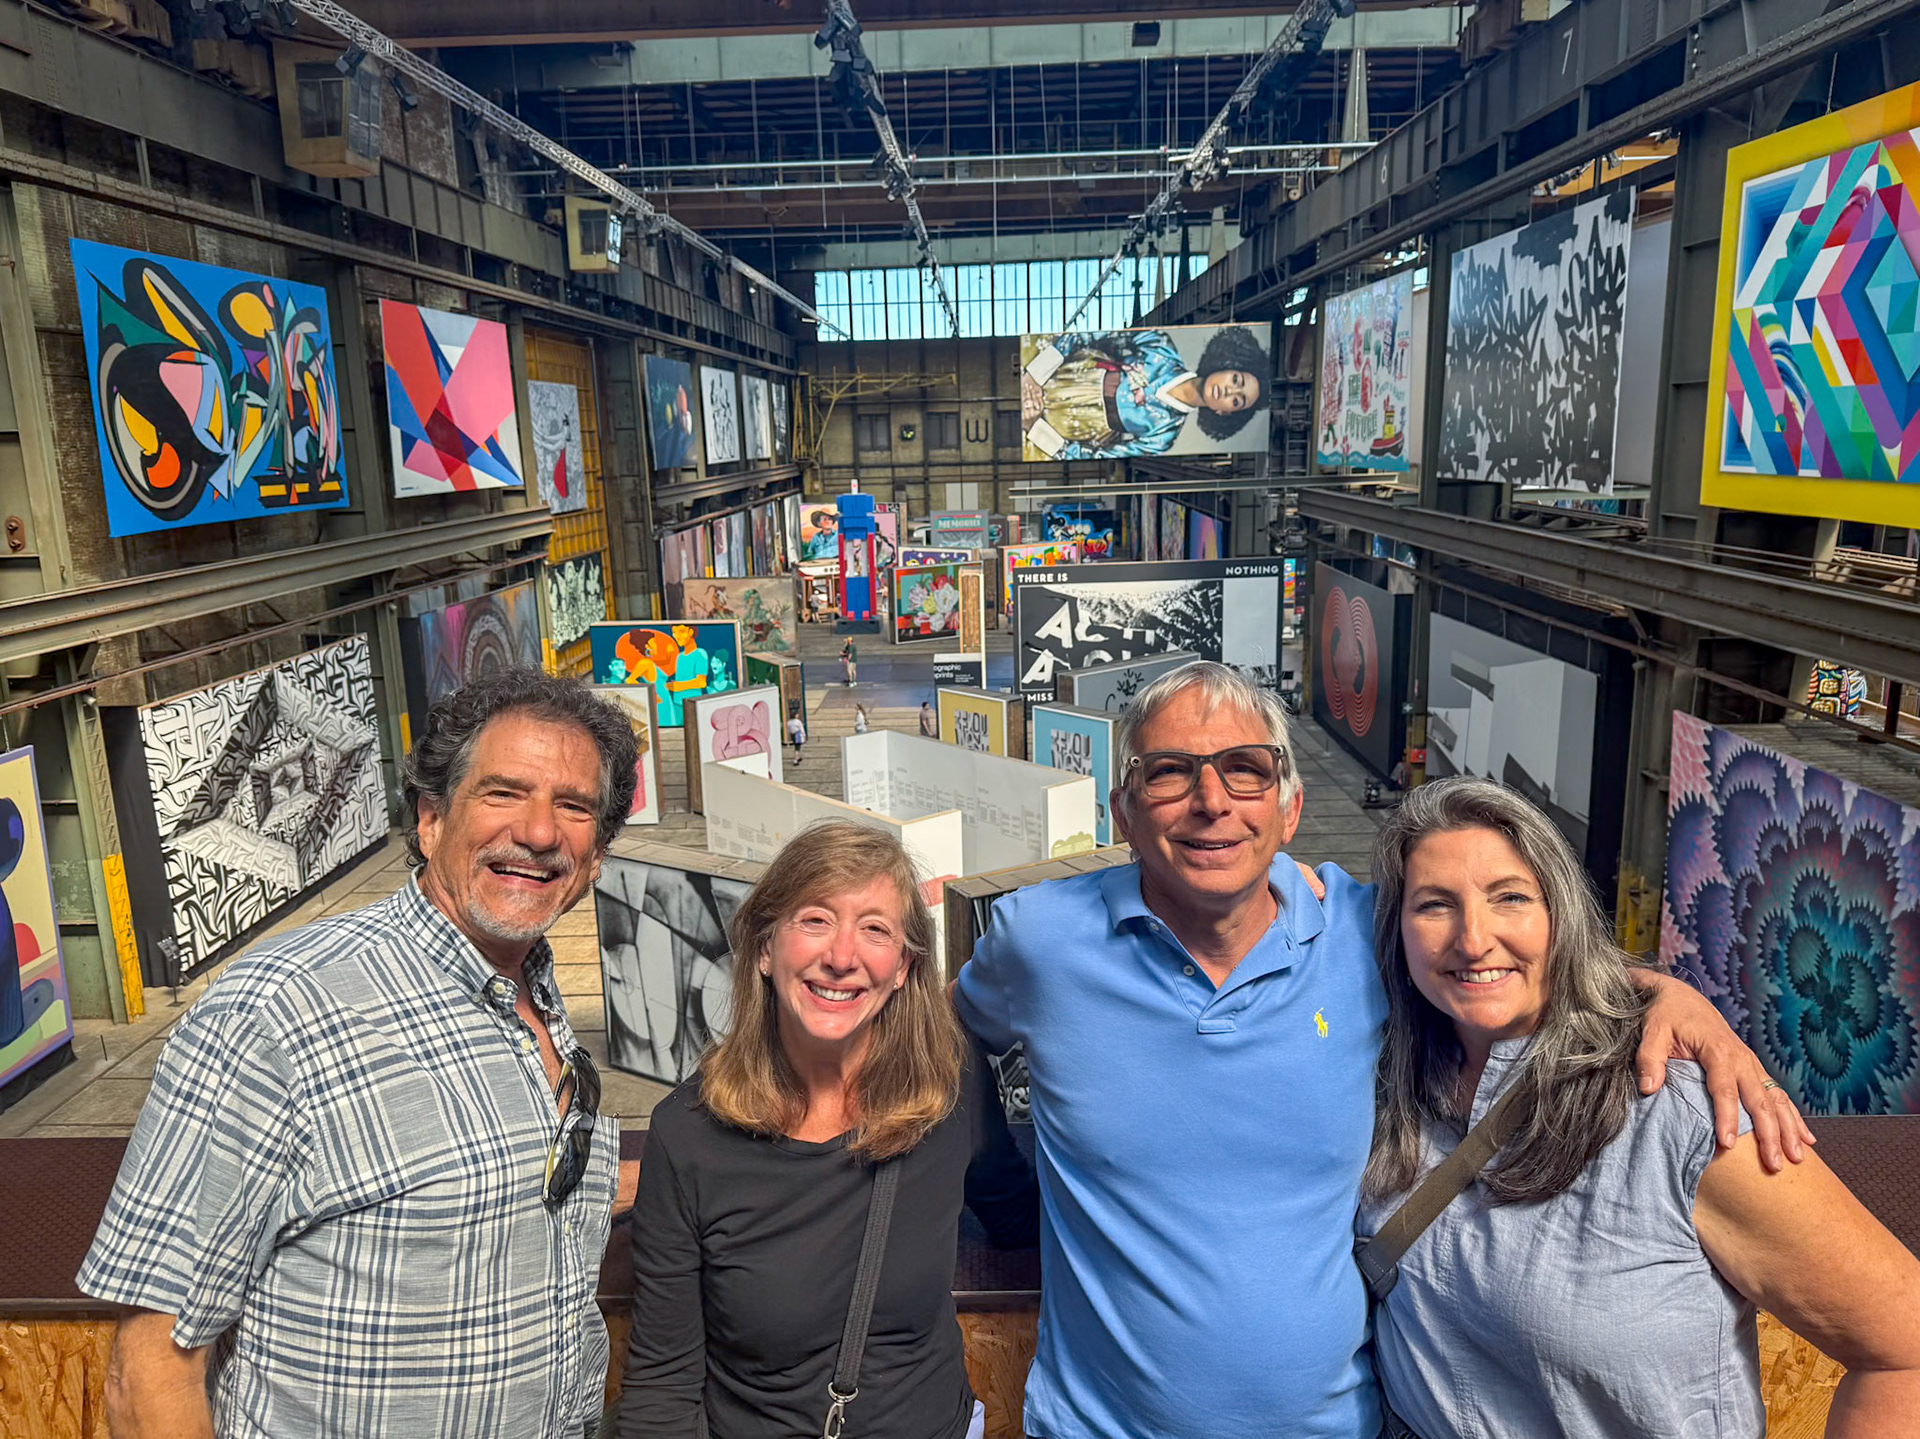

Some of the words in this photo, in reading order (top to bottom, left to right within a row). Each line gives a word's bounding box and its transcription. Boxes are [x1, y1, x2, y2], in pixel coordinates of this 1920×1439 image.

[1562, 26, 1574, 76] 7
[1380, 154, 1388, 185] 6
[1225, 565, 1279, 576] NOTHING
[1017, 573, 1054, 583] THERE
[1057, 572, 1068, 582] IS
[1027, 692, 1054, 702] MISS
